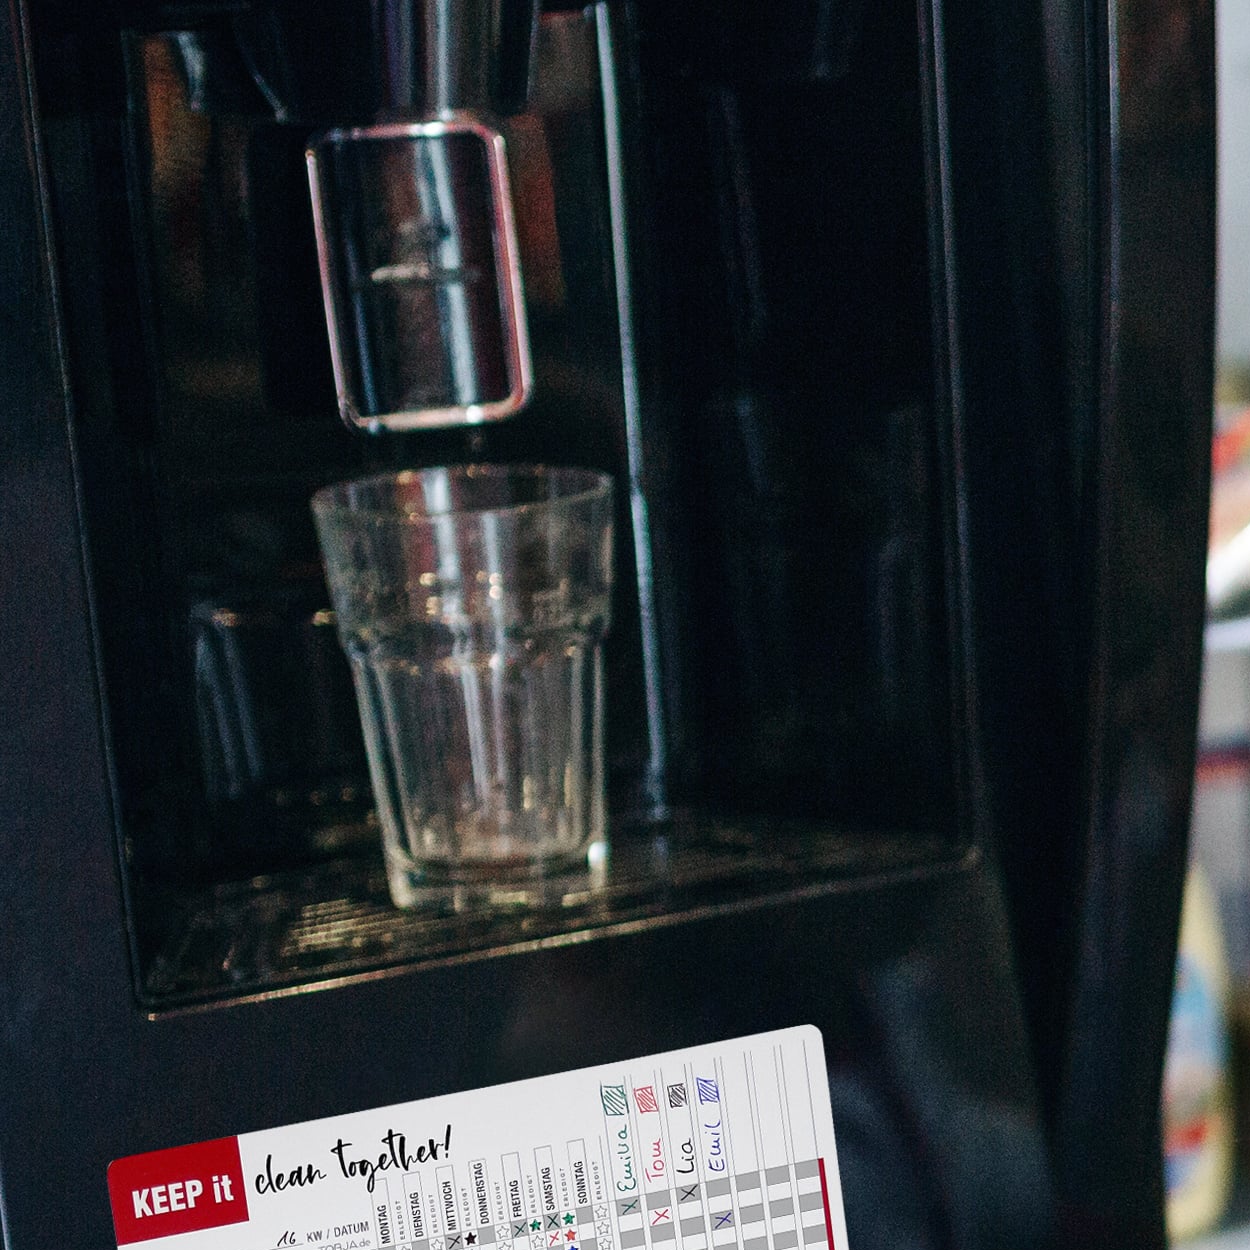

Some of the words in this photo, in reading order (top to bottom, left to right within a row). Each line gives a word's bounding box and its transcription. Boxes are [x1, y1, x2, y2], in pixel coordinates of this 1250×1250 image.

[644, 1137, 664, 1182] Tom
[675, 1138, 694, 1174] Lia
[703, 1120, 725, 1171] Emil
[132, 1179, 202, 1217] KEEP
[211, 1174, 234, 1203] it
[254, 1154, 325, 1194] clean
[331, 1125, 451, 1192] together!
[541, 1166, 555, 1210] SAMSTAG
[558, 1167, 569, 1207] ERLEDIGT
[573, 1160, 587, 1204] SONNTAG
[591, 1161, 602, 1200] ERLEDIGT
[442, 1180, 456, 1230] MITTWOCH
[460, 1187, 471, 1227] ERLEDIGT
[473, 1162, 489, 1224] DONNERSTAG
[493, 1181, 504, 1220] ERLEDIGT
[508, 1179, 522, 1217] FREITAG
[526, 1174, 536, 1213] ERLEDIGT
[306, 1230, 322, 1242] KW
[333, 1220, 369, 1237] DATUM
[376, 1204, 390, 1244] MONTAG
[394, 1200, 405, 1240] ERLEDIGT
[409, 1191, 423, 1237] DIENSTAG
[427, 1194, 438, 1233] ERLEDIGT
